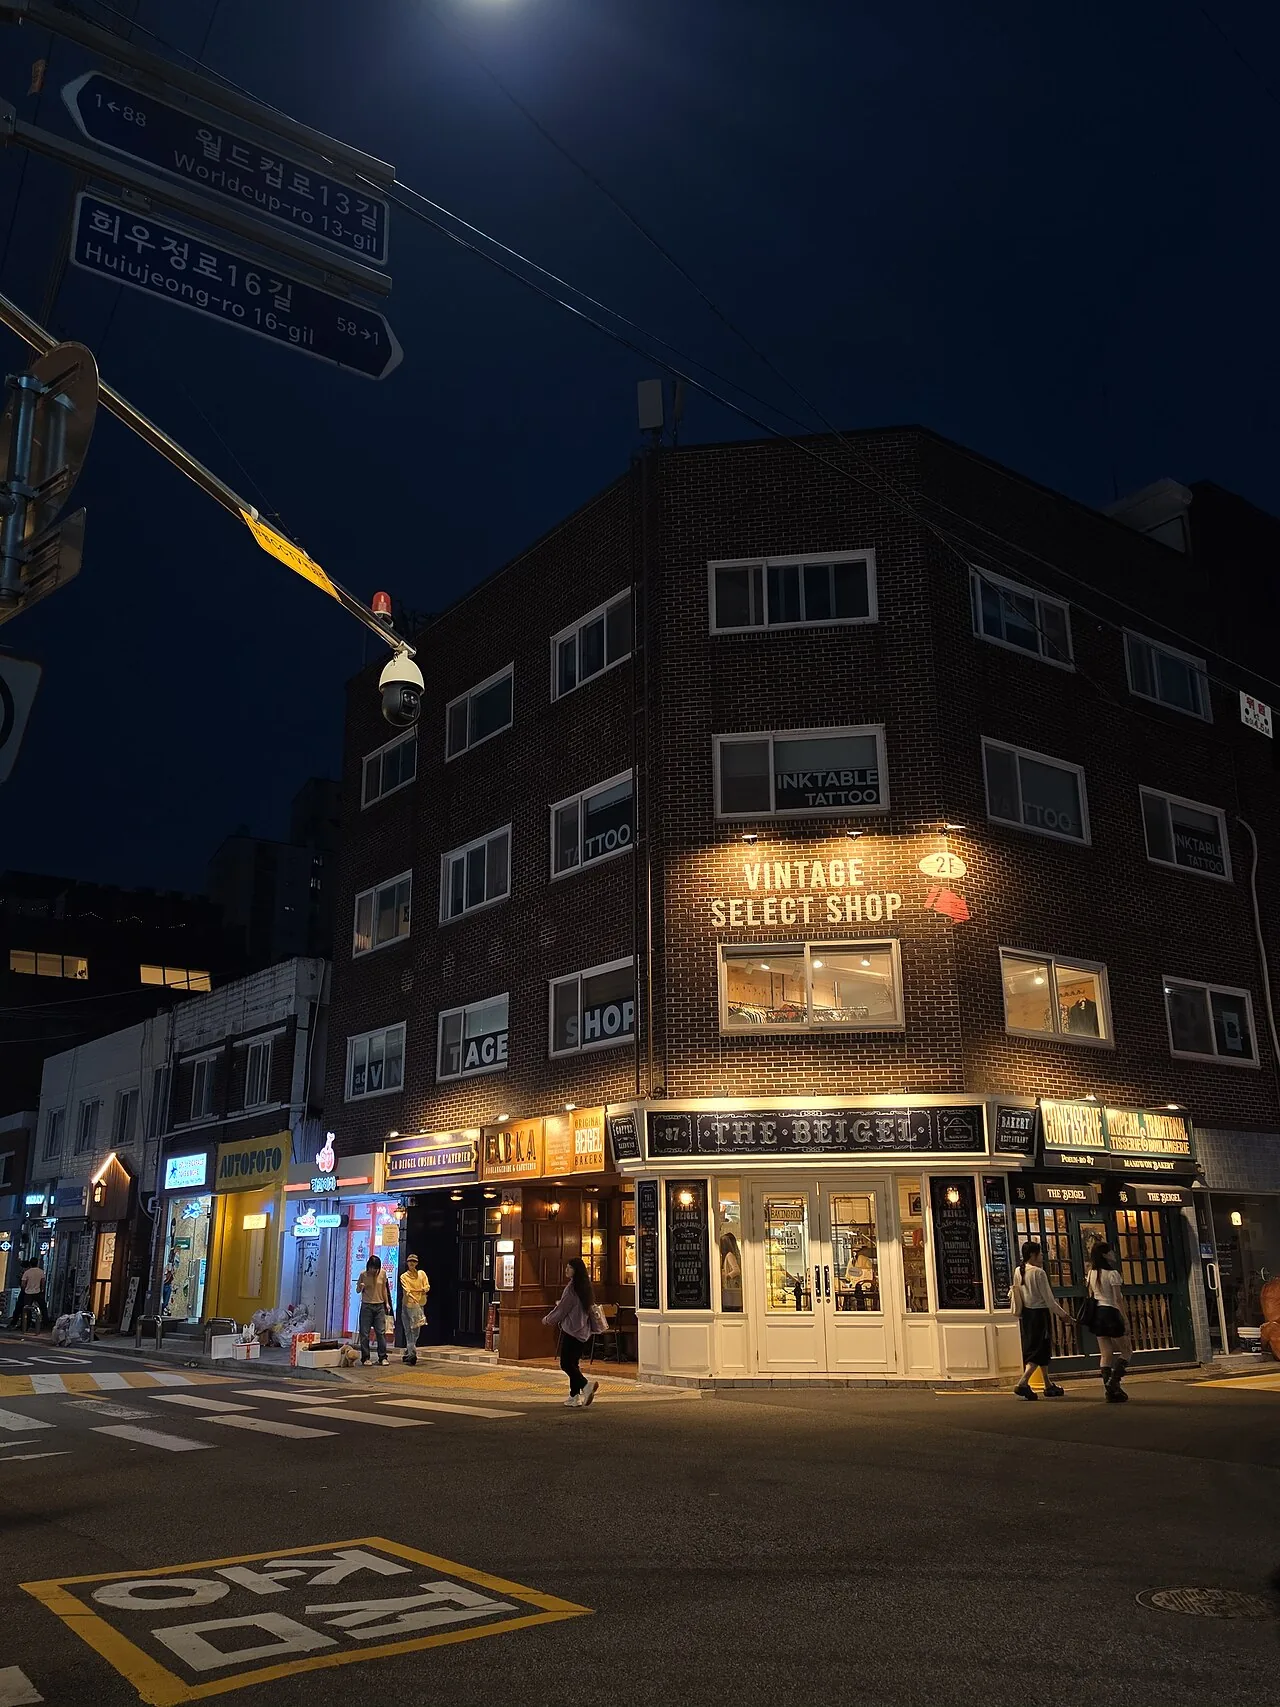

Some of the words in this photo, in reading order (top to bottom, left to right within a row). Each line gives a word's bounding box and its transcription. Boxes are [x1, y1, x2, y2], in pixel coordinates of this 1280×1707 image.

[123, 106, 147, 128] 88
[195, 128, 380, 232] 월드컵로13길
[173, 150, 314, 225] Worldcup-ro
[321, 214, 378, 254] 13-gil
[89, 209, 294, 313] 희우정로16길
[85, 242, 246, 318] Huiujeong-ro
[254, 307, 315, 346] 16-gil
[336, 316, 358, 338] 58
[777, 769, 879, 790] INKTABLE
[805, 789, 877, 806] TATTOO
[744, 859, 864, 890] VINTAGE
[1187, 854, 1223, 873] TATTOO
[711, 897, 813, 927] SELECT
[826, 893, 902, 923] SHOP
[565, 1001, 635, 1045] SHOP
[575, 1116, 603, 1128] ORIGINAL
[665, 1127, 680, 1141] 87
[711, 1121, 777, 1144] THE
[791, 1118, 918, 1144] BEIGEL
[1001, 1116, 1030, 1129] BAKERY
[1044, 1103, 1105, 1146] CONFISERIE
[1143, 1114, 1189, 1141] TRADITIONAL
[575, 1128, 603, 1154] BEIGEL
[1148, 1138, 1191, 1155] BOULANGERIE
[219, 1147, 282, 1179] AUTOFOTO
[574, 1154, 603, 1166] BAKERS
[1047, 1188, 1061, 1199] THE
[1061, 1188, 1087, 1201] BEIGEL
[1147, 1192, 1160, 1201] THE
[1160, 1193, 1182, 1204] BEIGEL
